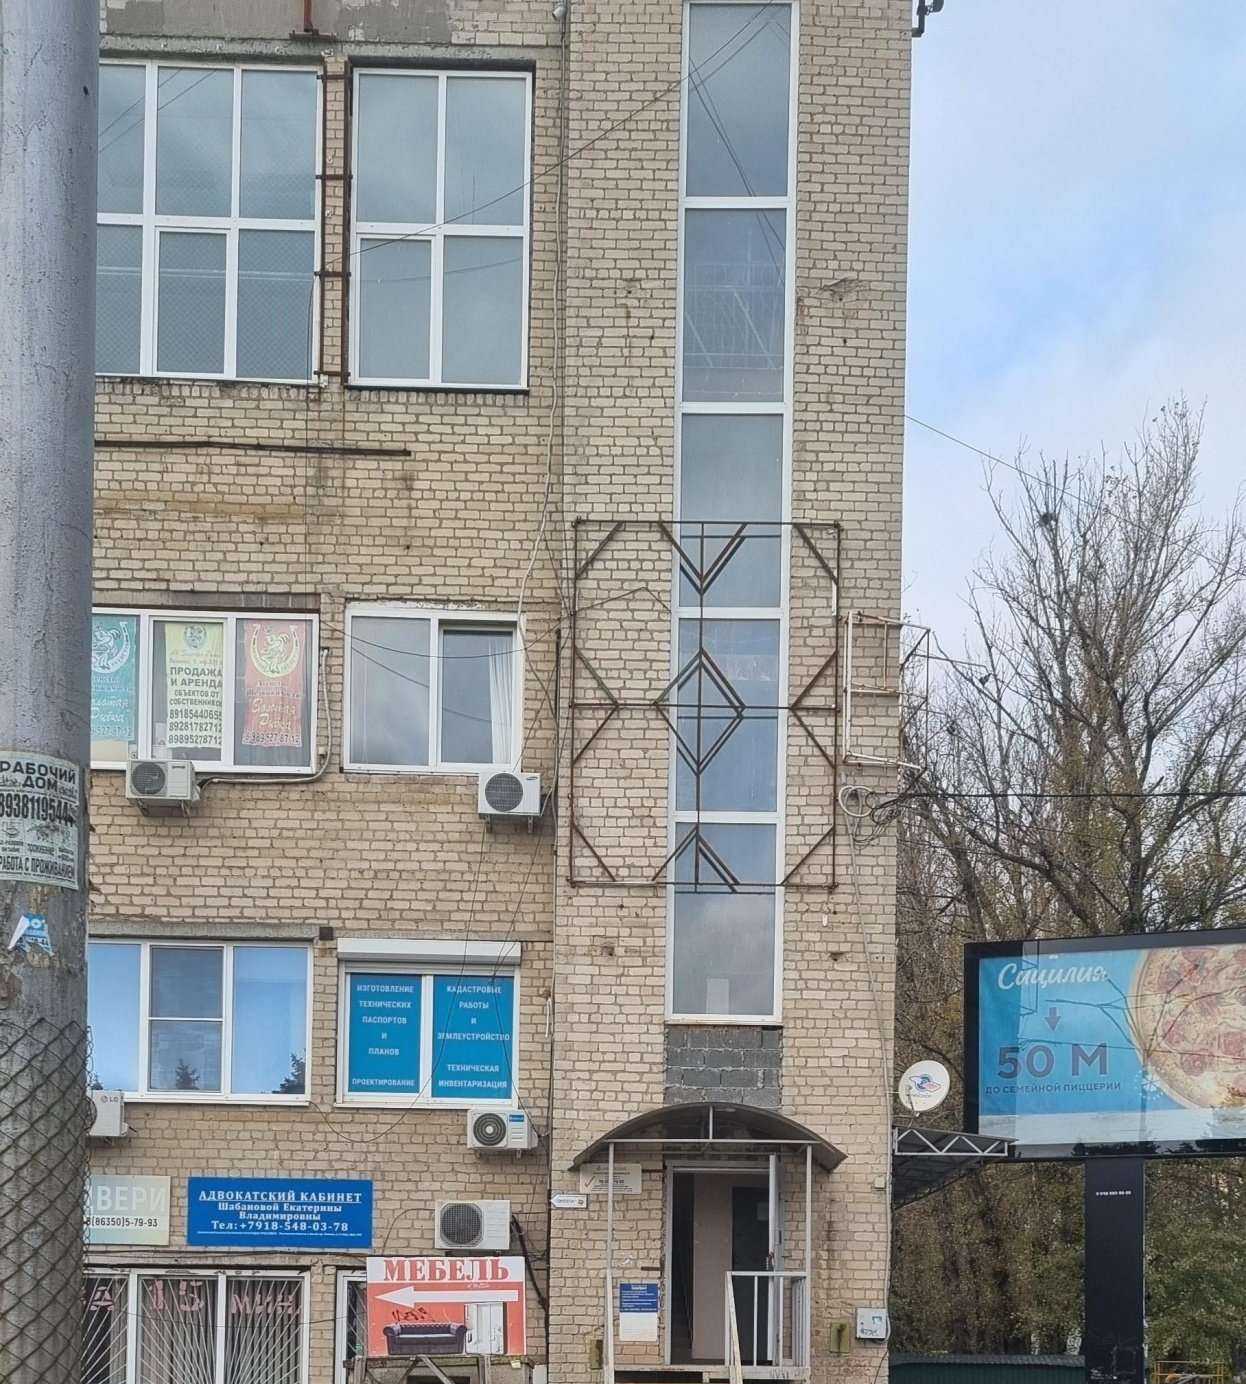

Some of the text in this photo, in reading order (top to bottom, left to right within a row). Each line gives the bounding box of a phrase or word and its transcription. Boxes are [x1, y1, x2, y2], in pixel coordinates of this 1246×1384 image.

[170, 666, 223, 678] ПРОДАЖА
[171, 678, 223, 690] И АРЕНДА
[174, 689, 219, 698] ОБЪЕКТОВ ОТ
[0, 760, 76, 784] РАБОЧИЙ
[22, 775, 59, 792] ДОМ
[356, 984, 414, 993] ИЗГОТОВЛЕНИЕ
[359, 1000, 411, 1009] ТЕХНИЧЕСКИХ
[458, 1000, 489, 1009] РАБОТЫ
[362, 1015, 407, 1025] ПАСПОРТОВ
[471, 1017, 477, 1025] И
[381, 1031, 388, 1040] И
[368, 1047, 400, 1056] ПЛАНОВ
[998, 1044, 1055, 1079] 50
[447, 1063, 500, 1073] ТЕХНИЧЕСКАЯ
[351, 1077, 415, 1087] ПРОЕКТИРОВАНИЕ
[438, 1079, 508, 1089] ИНВЕНТАРИЗАЦИЯ
[986, 1082, 1121, 1095] ДО СЕМЕЙНОЙ ПИЦЦЕРИИ
[199, 1190, 362, 1203] АДВОКАТСКИЙ КАБИНЕТ
[218, 1202, 342, 1213] Шабановой Екатерины
[239, 1211, 321, 1222] Владимировны
[383, 1258, 509, 1281] МЕБЕЛЬ
